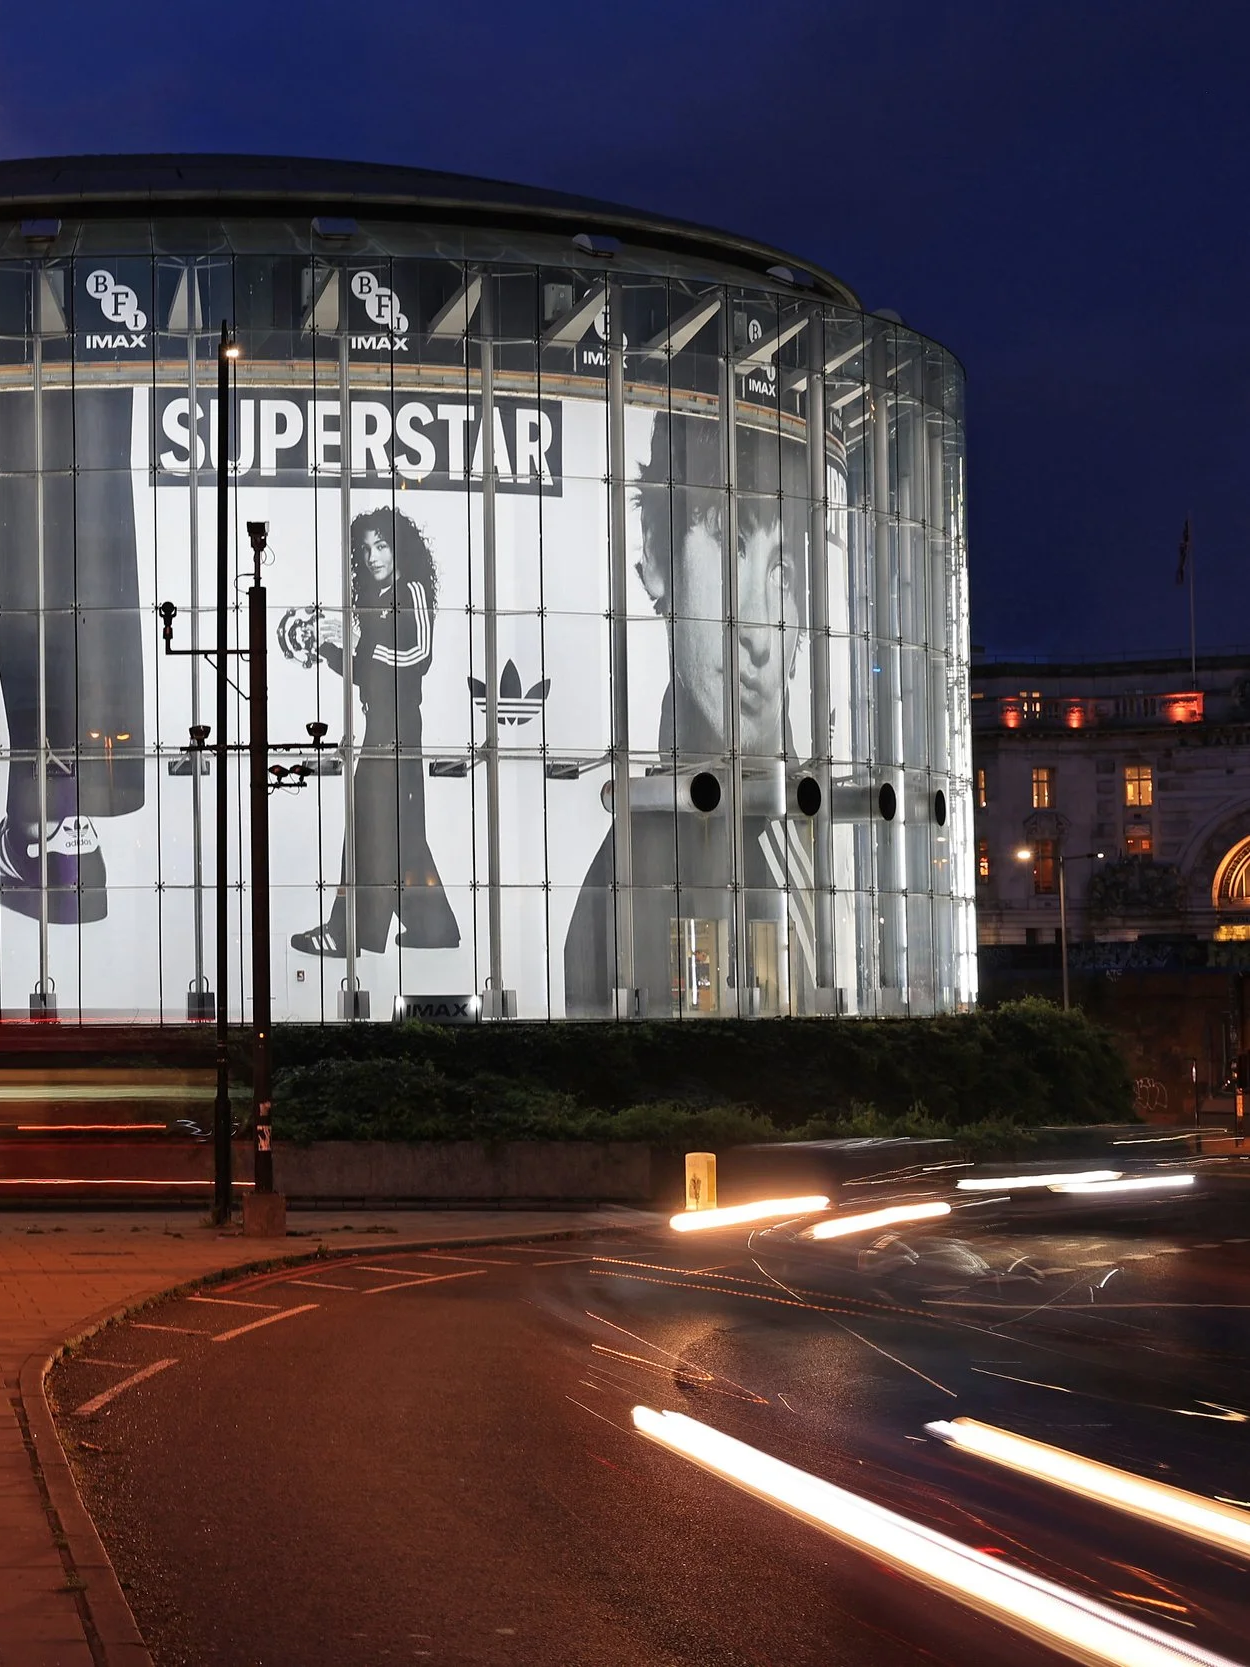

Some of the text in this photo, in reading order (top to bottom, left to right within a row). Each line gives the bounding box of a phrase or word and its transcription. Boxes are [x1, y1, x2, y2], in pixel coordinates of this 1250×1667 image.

[86, 334, 147, 349] IMAX
[351, 337, 409, 351] IMAX
[749, 378, 776, 397] IMAX
[160, 397, 554, 486] SUPERSTAR
[406, 1003, 469, 1018] IMAX
